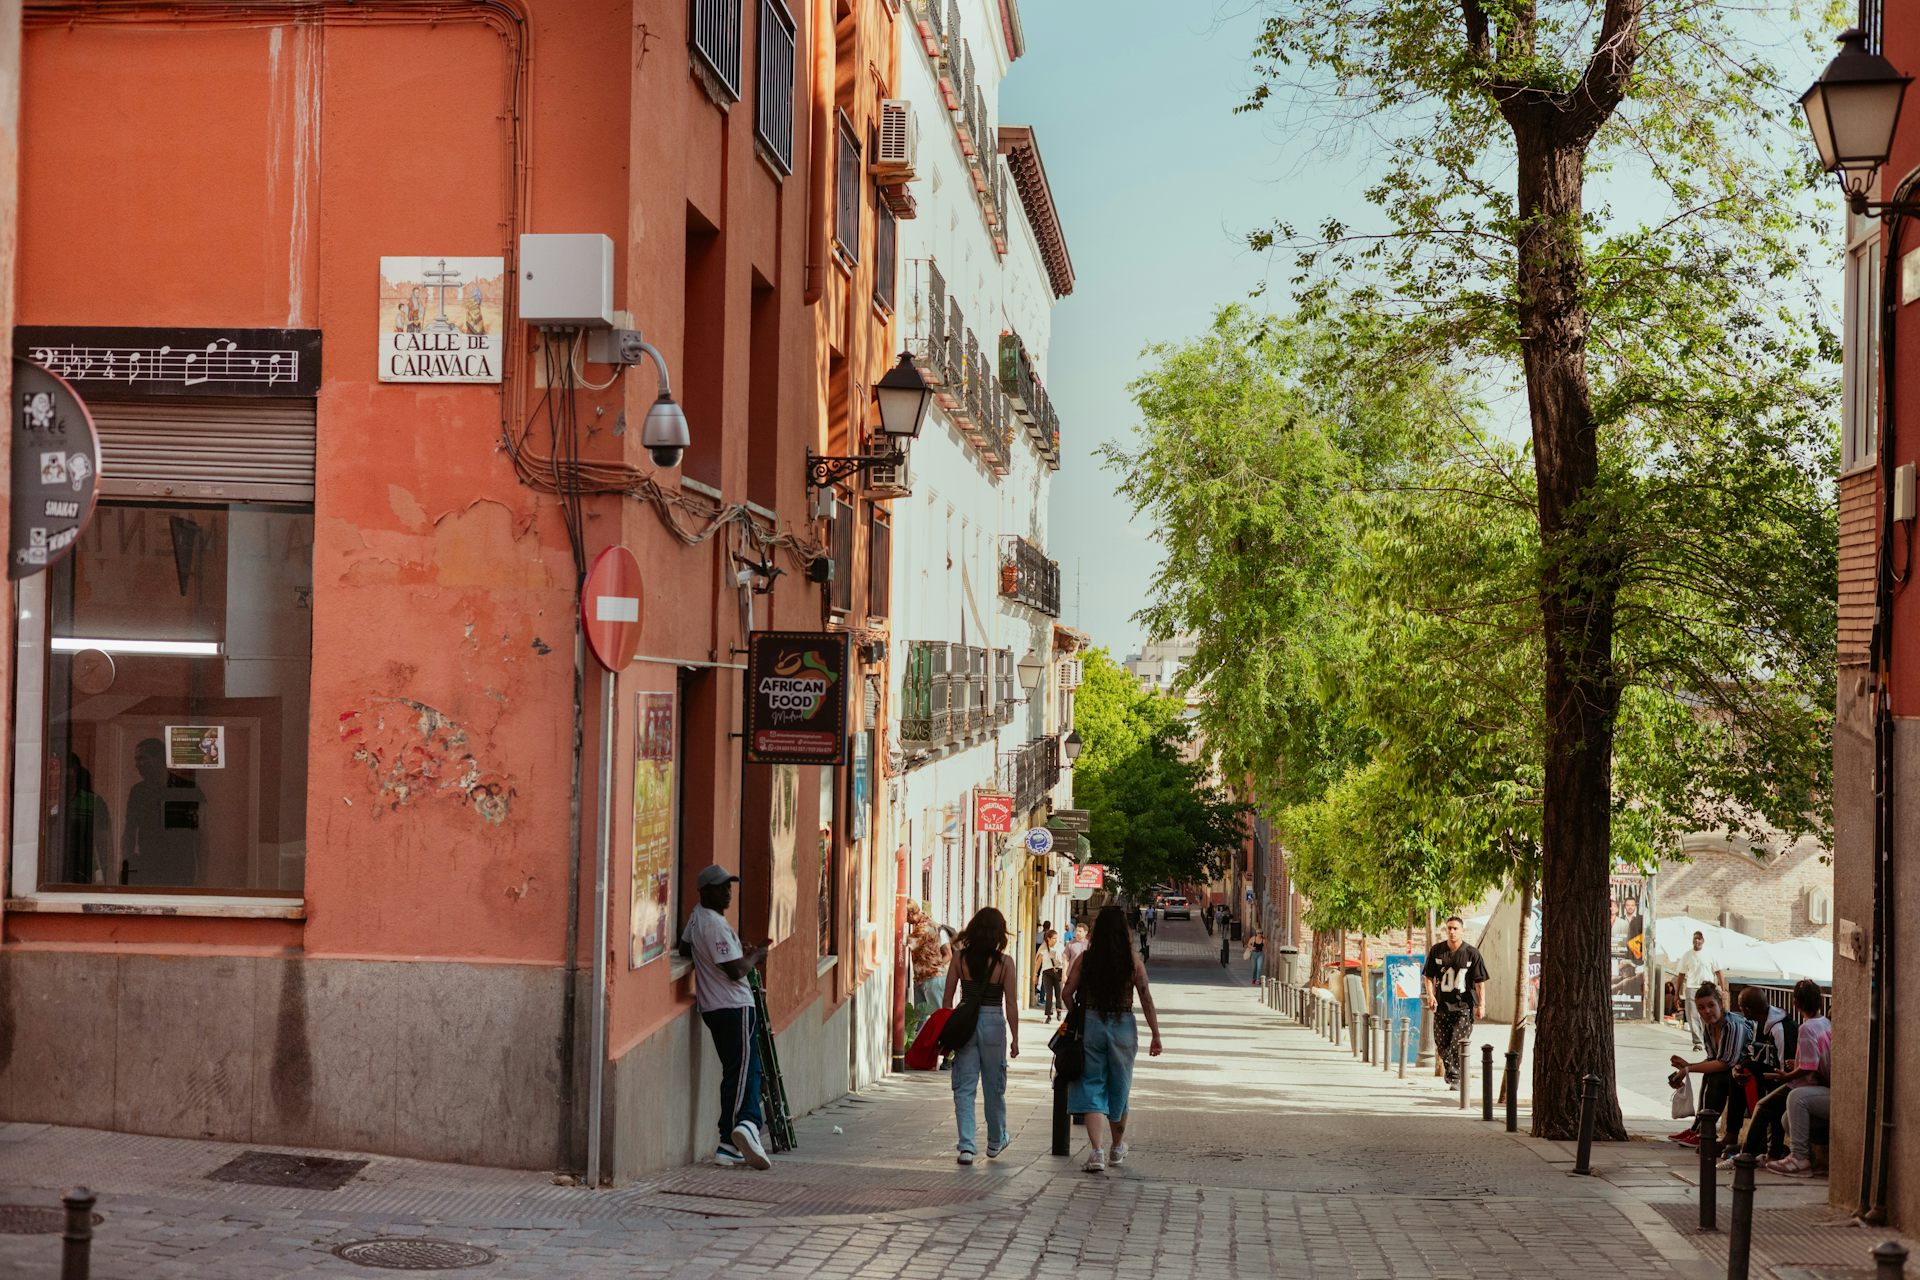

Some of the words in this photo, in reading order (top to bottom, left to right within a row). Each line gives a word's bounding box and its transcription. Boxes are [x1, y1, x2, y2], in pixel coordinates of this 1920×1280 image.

[394, 333, 461, 351] CALLE
[467, 335, 489, 349] DE
[391, 354, 493, 377] CARAVACA
[760, 679, 825, 694] AFRICAN
[770, 694, 813, 708] FOOD
[771, 710, 803, 725] Madrid
